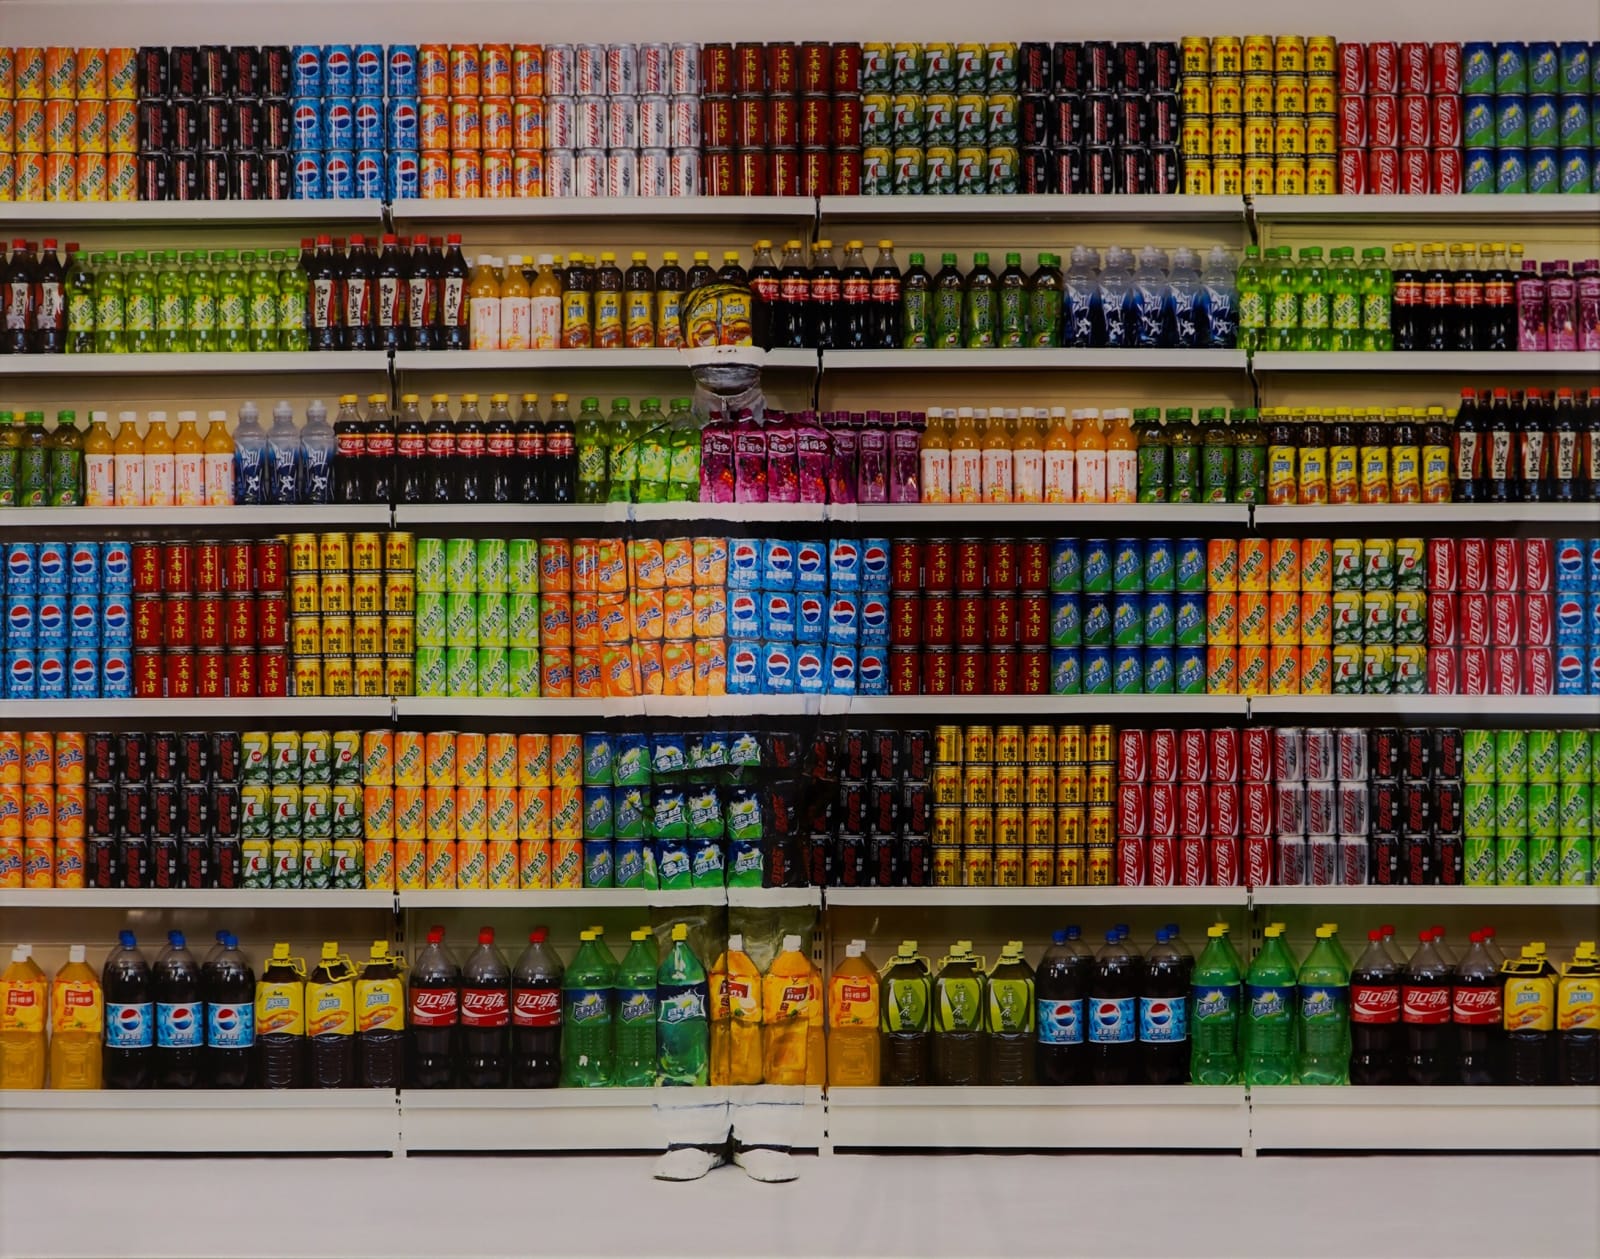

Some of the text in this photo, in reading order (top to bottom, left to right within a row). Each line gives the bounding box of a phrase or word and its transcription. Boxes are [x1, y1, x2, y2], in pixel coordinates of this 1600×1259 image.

[144, 548, 154, 584] 王老吉
[203, 548, 214, 584] 王老吉
[266, 548, 276, 584] 王老吉
[902, 547, 912, 582] 王老吉
[965, 547, 976, 582] 王老吉
[1031, 547, 1042, 582] 王老吉
[1334, 549, 1353, 576] 7
[1365, 549, 1383, 576] 7
[1397, 549, 1414, 575] 7
[1435, 542, 1449, 588] 可口可乐
[1465, 542, 1479, 588] 可口可乐
[1496, 542, 1509, 588] 可口可乐
[1526, 542, 1541, 588] 可口可乐
[138, 603, 149, 639] 王老吉
[204, 603, 214, 639] 王老吉
[236, 603, 247, 639] 王老吉
[266, 603, 276, 639] 王老吉
[902, 602, 912, 637] 王老吉
[933, 602, 944, 637] 王老吉
[964, 602, 975, 637] 王老吉
[1029, 602, 1039, 637] 王老吉
[1333, 602, 1352, 629] 7
[1364, 602, 1382, 629] 7
[1432, 597, 1447, 643] 可口可乐
[1470, 597, 1483, 643] 可口可乐
[1496, 597, 1510, 643] 可口可乐
[1528, 597, 1542, 643] 可口可乐
[145, 657, 156, 693] 王老吉
[207, 657, 218, 693] 王老吉
[267, 657, 278, 693] 王老吉
[902, 656, 912, 691] 王老吉
[964, 656, 975, 691] 王老吉
[1029, 656, 1039, 691] 王老吉
[1333, 656, 1352, 682] 7
[244, 742, 261, 768] 7
[273, 742, 291, 768] 7
[334, 742, 351, 768] 7
[1124, 733, 1137, 779] 可口可乐
[1156, 733, 1168, 779] 可口可乐
[1186, 733, 1200, 779] 可口可乐
[1216, 733, 1229, 779] 可口可乐
[1249, 733, 1263, 779] 可口可乐
[273, 796, 290, 822] 7
[303, 796, 318, 822] 7
[1123, 787, 1136, 833] 可口可乐
[1153, 787, 1166, 833] 可口可乐
[1186, 787, 1200, 833] 可口可乐
[1218, 787, 1232, 833] 可口可乐
[1249, 787, 1264, 833] 可口可乐
[244, 850, 261, 876] 7
[274, 850, 291, 876] 7
[417, 992, 457, 1008] 可口可乐
[464, 992, 506, 1008] 可口可乐
[517, 993, 558, 1008] 可口可乐
[1358, 989, 1398, 1006] 可口可乐
[1408, 989, 1448, 1006] 可口可乐
[1456, 989, 1497, 1006] 可口可乐
